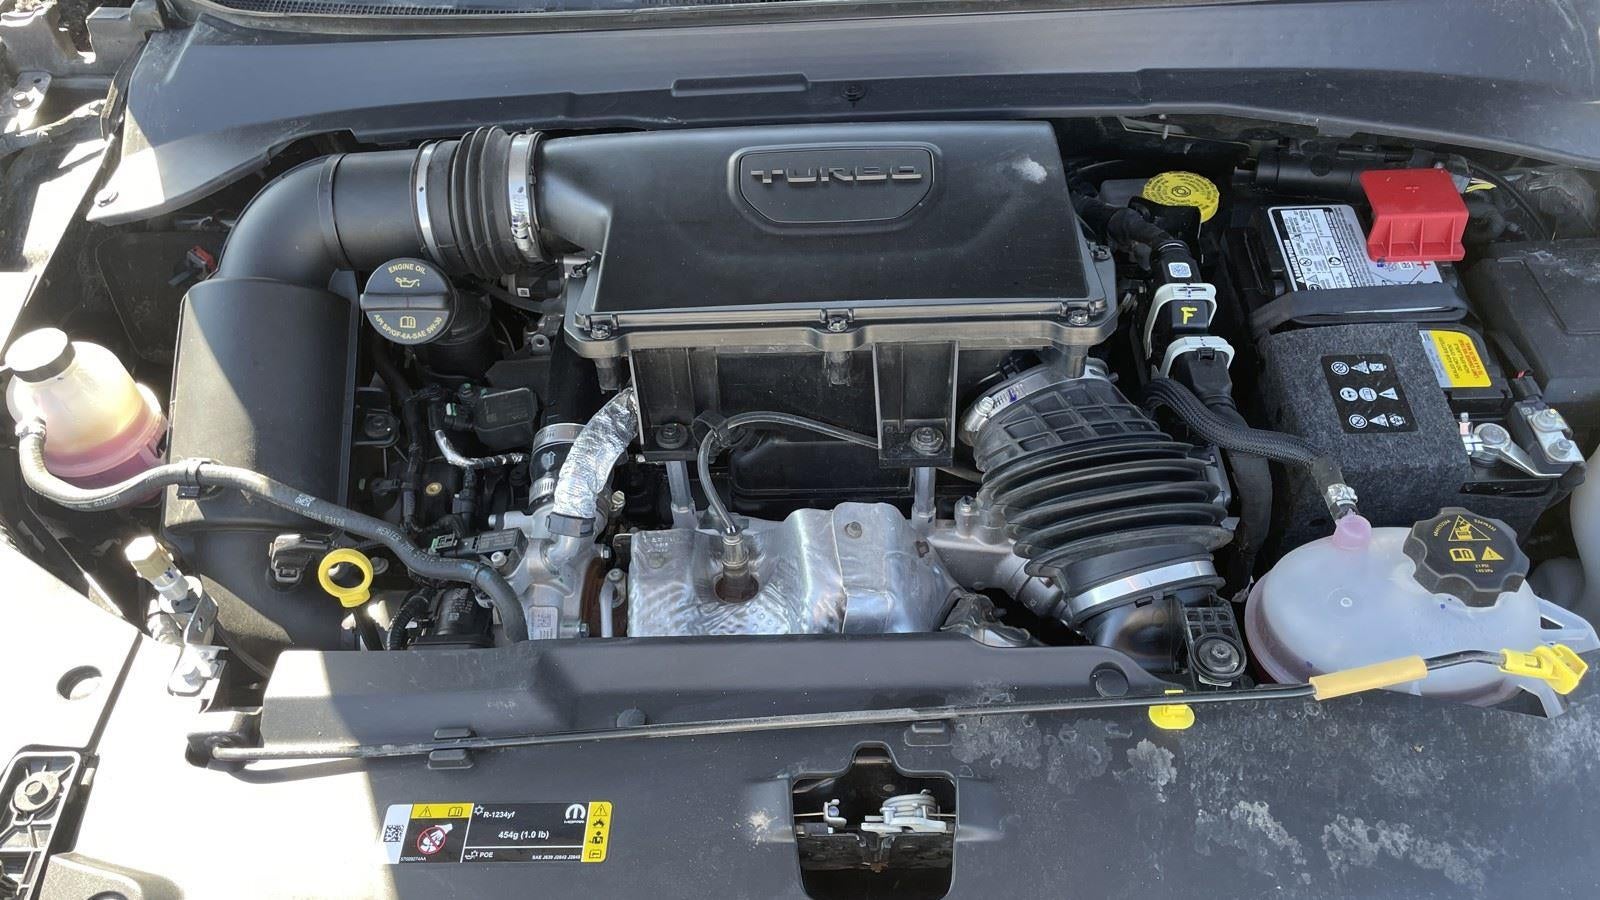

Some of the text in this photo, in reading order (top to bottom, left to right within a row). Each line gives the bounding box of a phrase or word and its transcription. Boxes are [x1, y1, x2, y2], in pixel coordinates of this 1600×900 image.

[750, 166, 922, 184] TURBO
[388, 264, 426, 274] ENGINE OIL
[1180, 306, 1198, 324] F
[483, 811, 515, 819] R-1234yf
[498, 830, 549, 840] 454g (1.0 lb)
